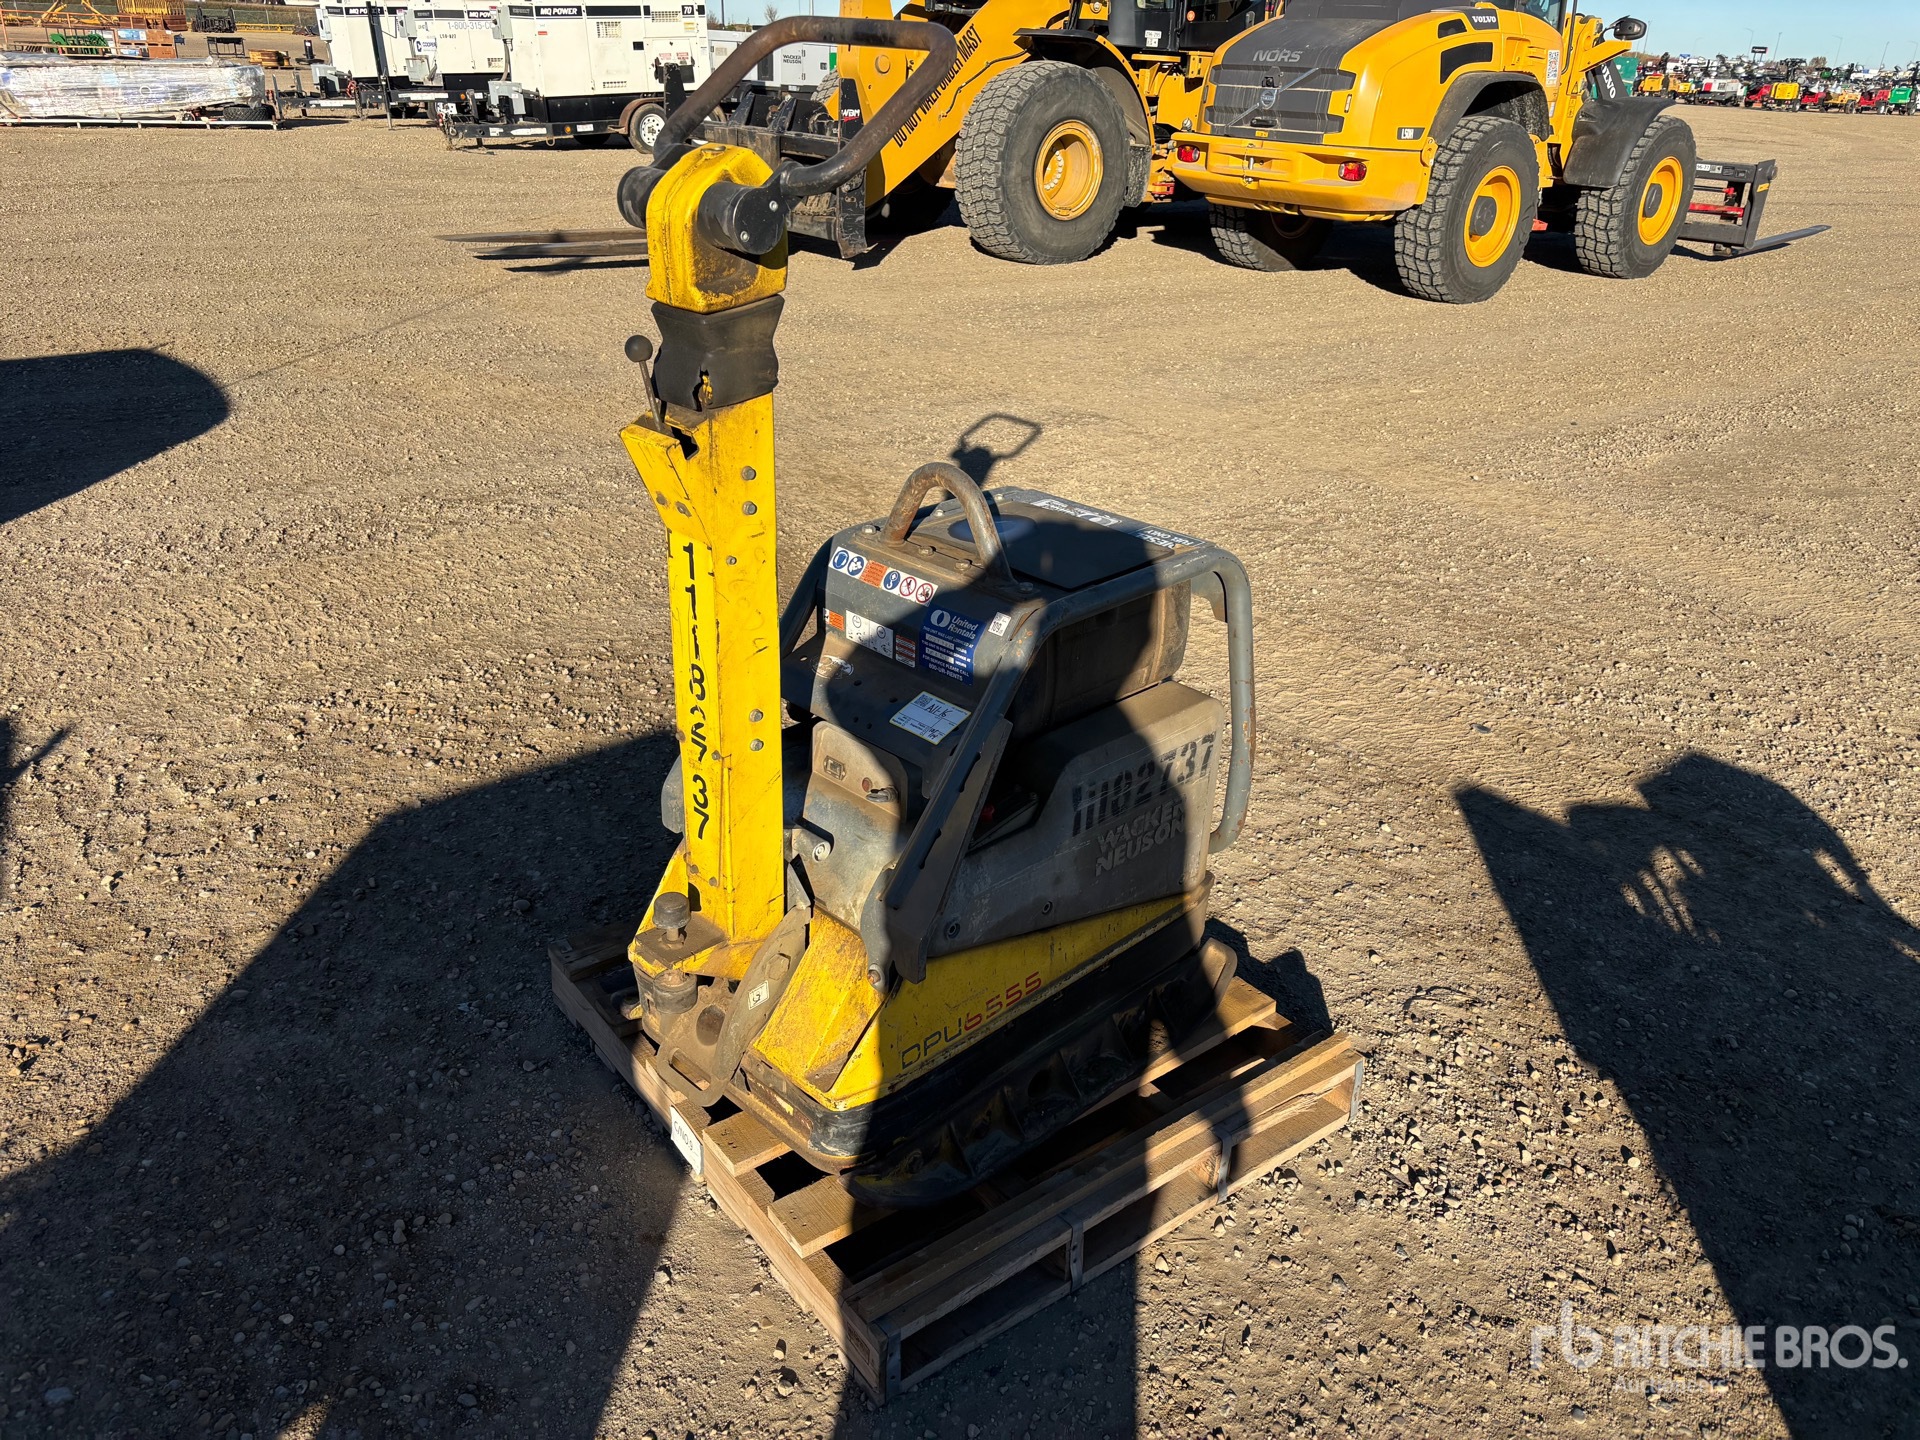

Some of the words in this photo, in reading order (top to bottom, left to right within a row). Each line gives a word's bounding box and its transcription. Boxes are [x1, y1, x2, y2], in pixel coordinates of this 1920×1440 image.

[684, 6, 692, 14] 70
[1472, 15, 1496, 23] VOLVO
[957, 23, 982, 62] MAST
[1253, 50, 1302, 63] NORS
[1601, 64, 1616, 99] OLVO
[841, 109, 860, 117] WBM
[951, 615, 979, 632] United
[947, 624, 977, 640] Rentals
[1095, 818, 1185, 877] NEUSON
